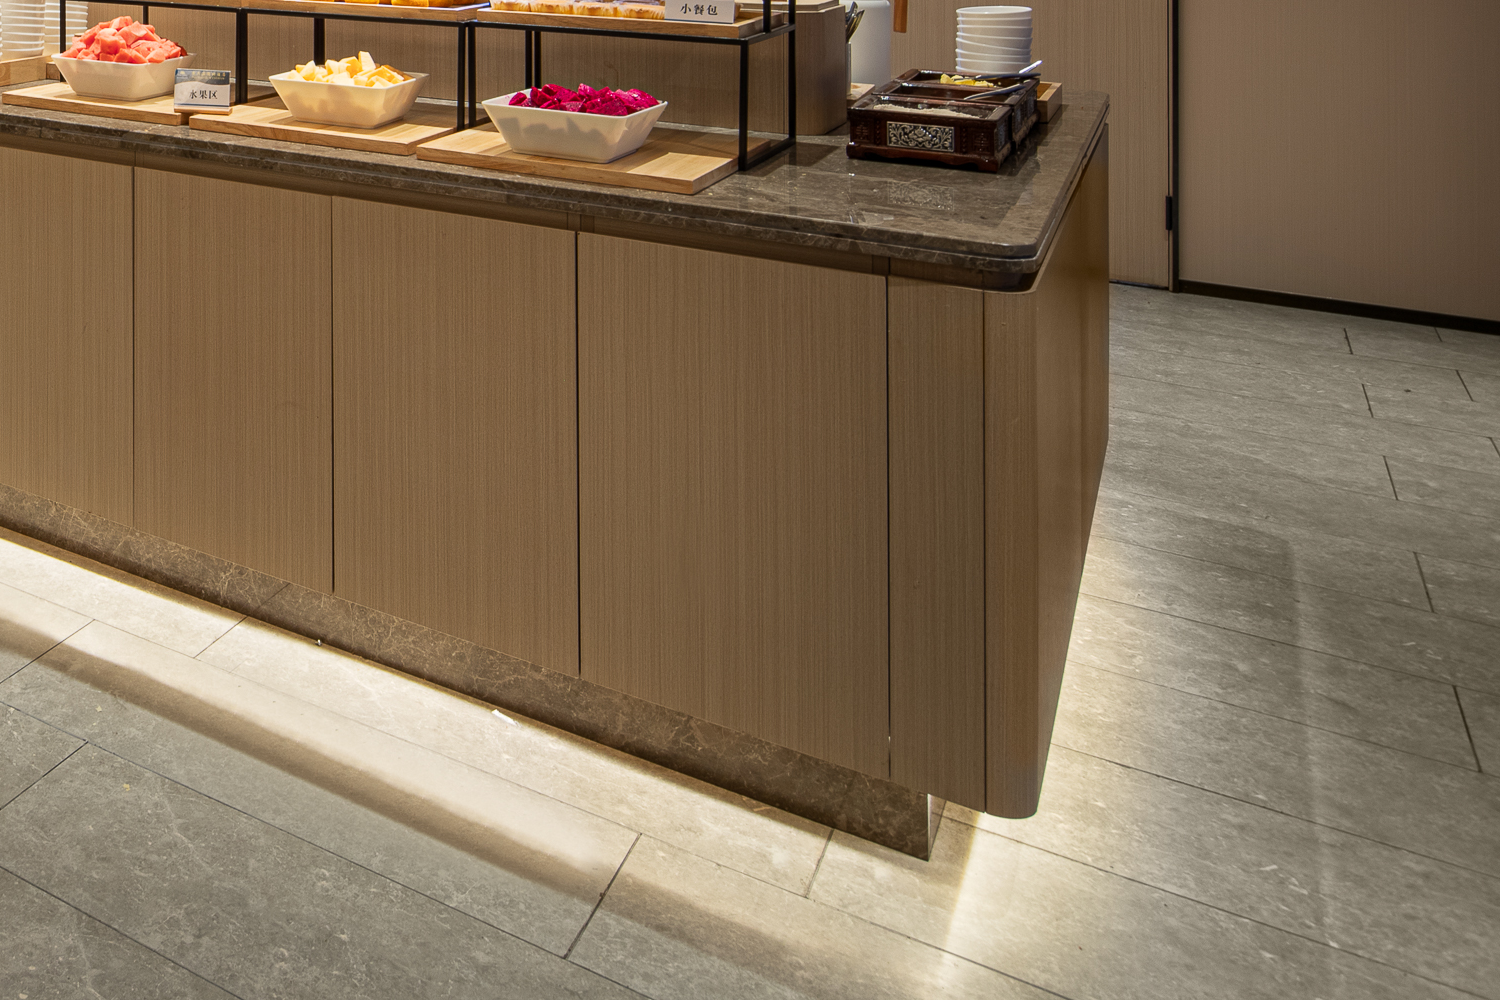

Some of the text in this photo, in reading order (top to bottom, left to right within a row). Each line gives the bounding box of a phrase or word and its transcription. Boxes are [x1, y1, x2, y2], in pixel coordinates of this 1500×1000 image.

[680, 3, 718, 15] 小餐包
[190, 90, 218, 99] 水果区
